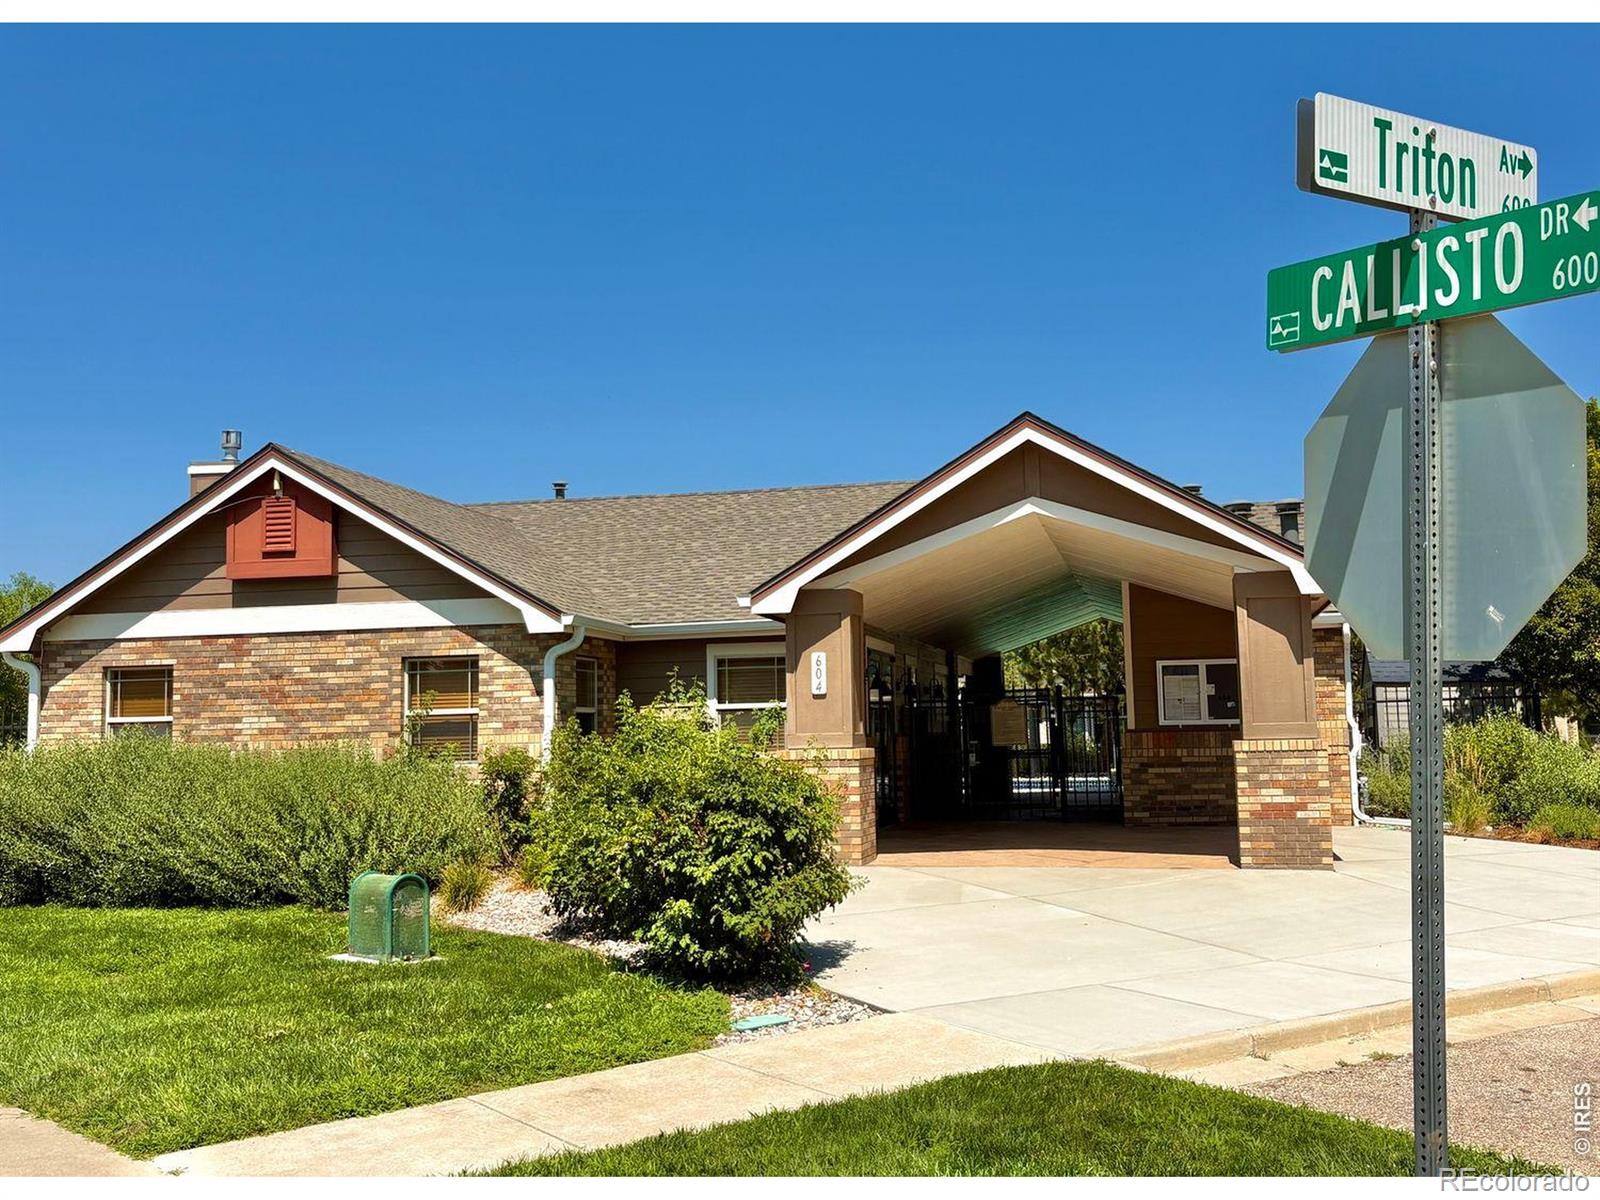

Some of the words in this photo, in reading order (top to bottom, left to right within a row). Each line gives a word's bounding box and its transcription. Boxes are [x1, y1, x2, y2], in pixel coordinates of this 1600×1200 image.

[1373, 117, 1477, 210] Triton
[1499, 144, 1517, 175] Av
[1310, 221, 1524, 331] CALLISTO
[1540, 203, 1569, 240] DR
[1552, 251, 1598, 290] 600
